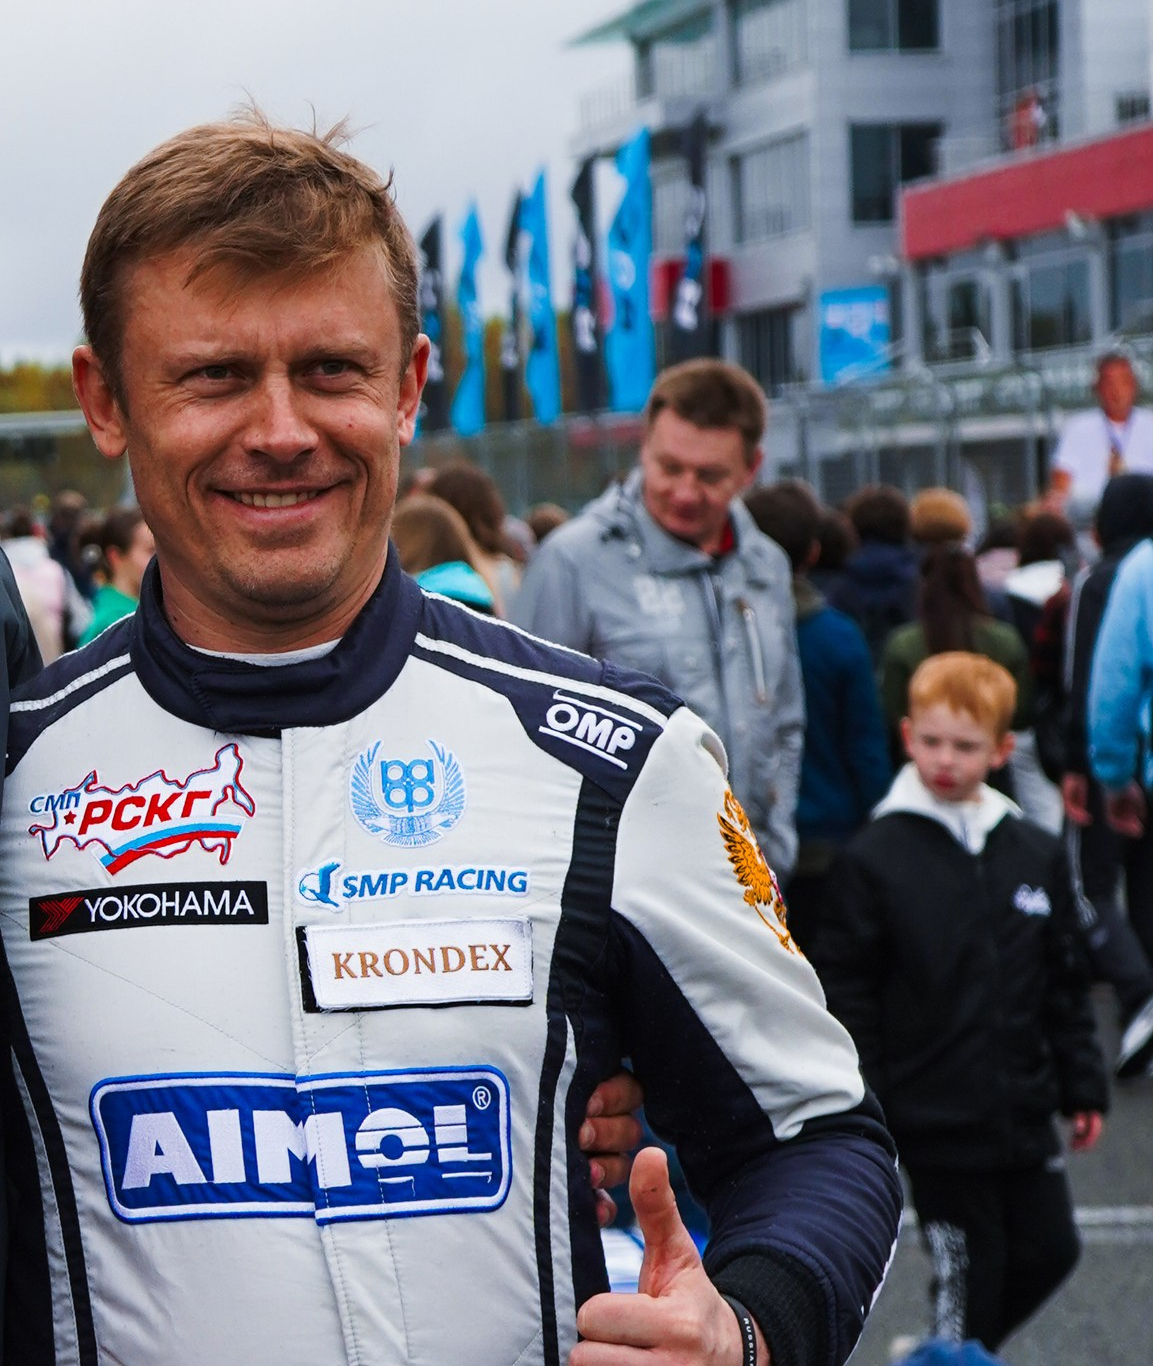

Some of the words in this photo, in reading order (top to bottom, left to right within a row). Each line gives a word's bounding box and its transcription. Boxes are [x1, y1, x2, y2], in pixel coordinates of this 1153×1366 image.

[546, 703, 636, 755] OMP
[30, 792, 81, 812] СМП
[78, 790, 212, 836] РСКГ
[342, 872, 408, 899] SMP
[415, 868, 528, 893] RACING
[84, 890, 255, 923] YOKOHAMA
[332, 944, 513, 980] KRONDEX
